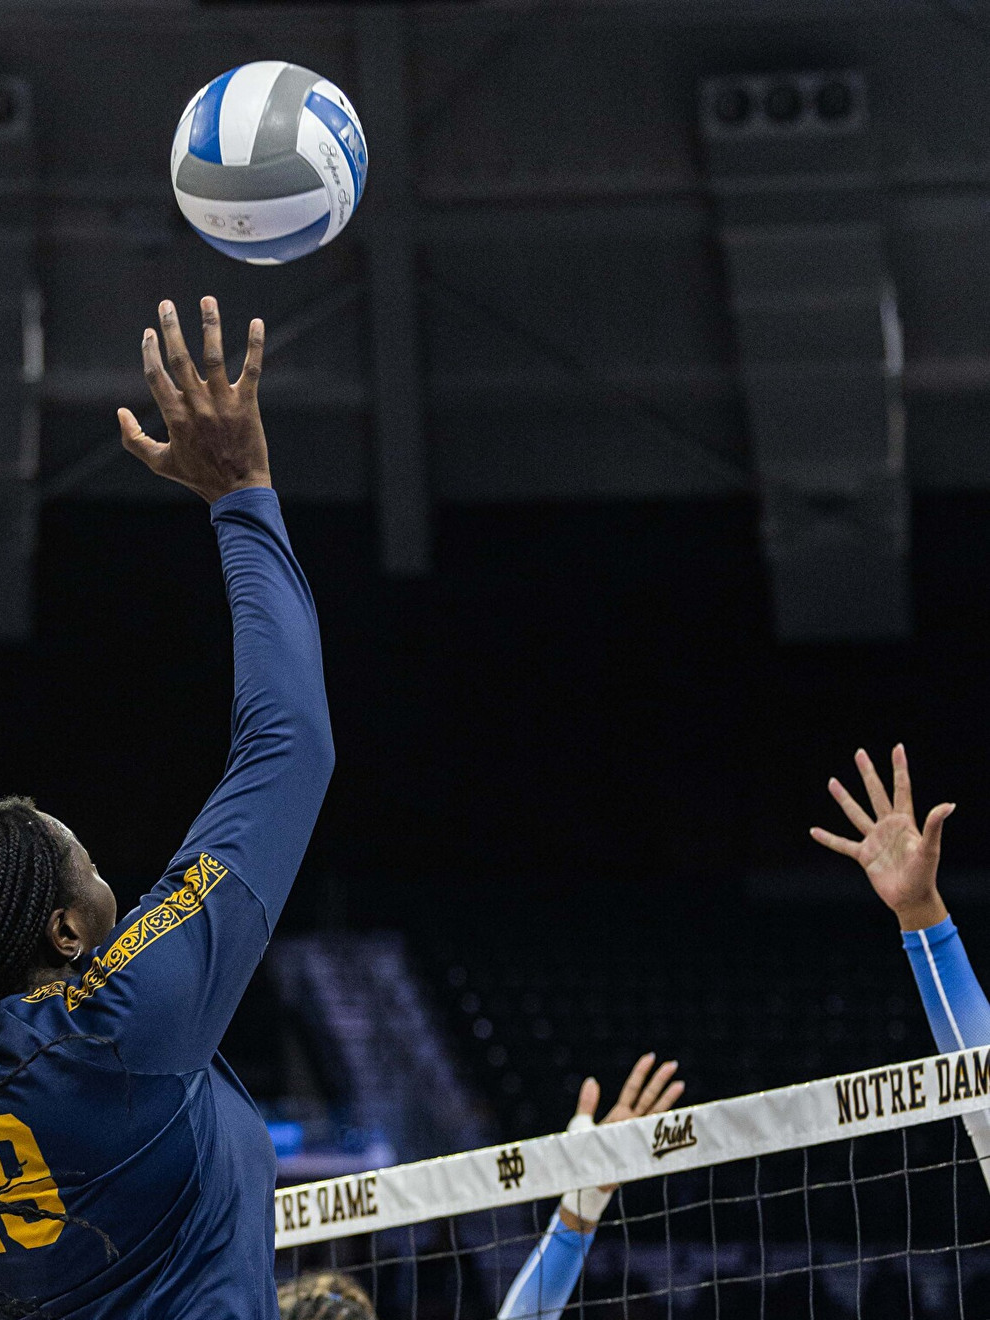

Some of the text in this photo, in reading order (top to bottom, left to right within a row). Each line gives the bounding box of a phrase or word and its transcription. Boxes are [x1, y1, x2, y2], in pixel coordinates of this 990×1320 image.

[835, 1062, 927, 1126] NOTRE
[652, 1113, 698, 1160] Irish
[317, 1176, 378, 1225] DAME
